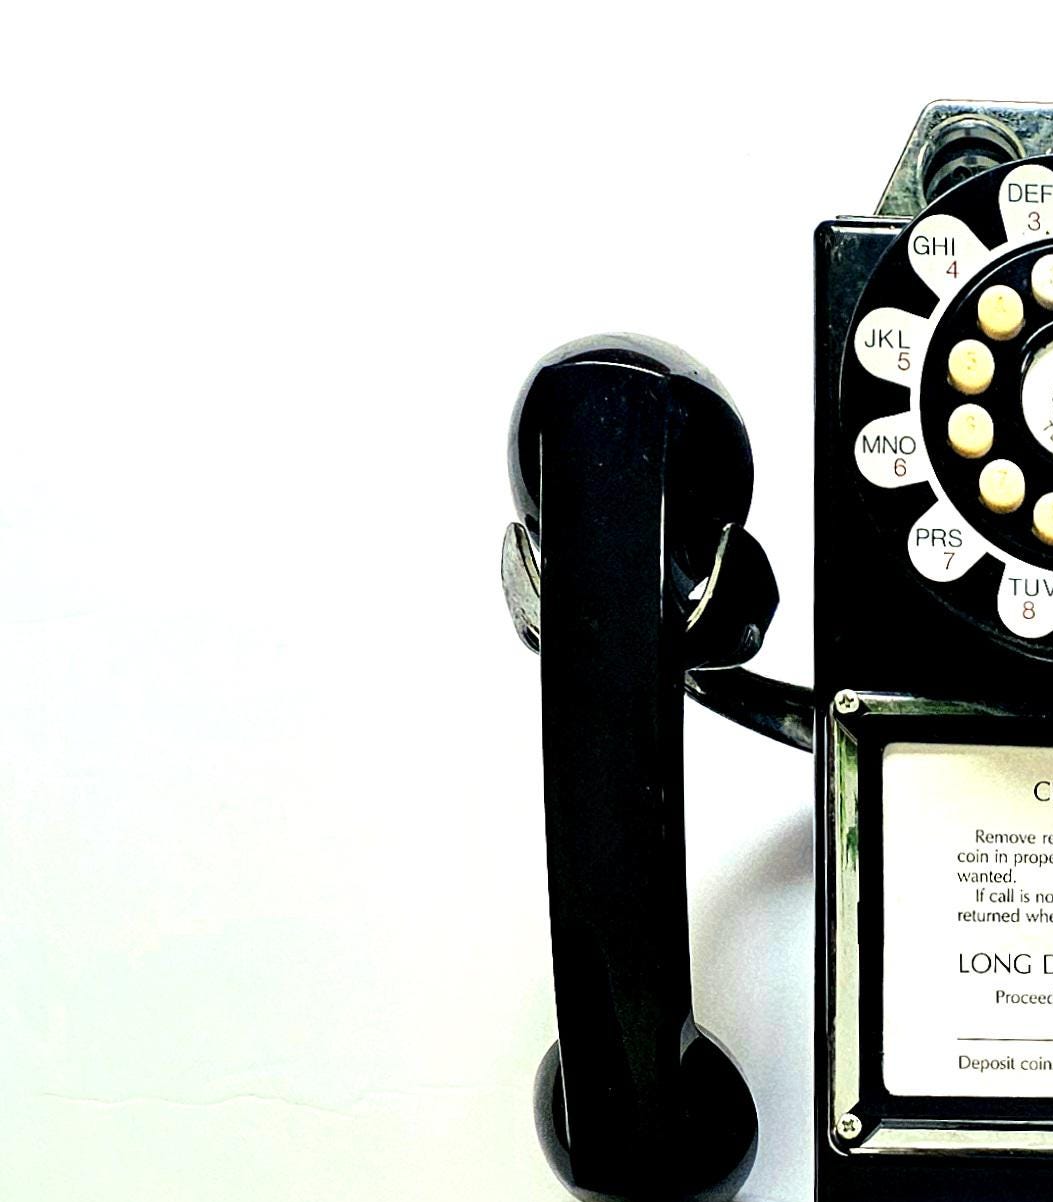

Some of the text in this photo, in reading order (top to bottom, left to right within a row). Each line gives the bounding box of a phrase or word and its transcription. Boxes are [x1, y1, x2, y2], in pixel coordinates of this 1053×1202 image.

[1009, 184, 1052, 203] DEF
[1028, 212, 1040, 231] 3
[914, 236, 954, 256] GHI
[946, 261, 957, 278] 4
[865, 329, 910, 349] JKL
[898, 352, 910, 371] 5
[863, 435, 916, 454] MNO
[894, 458, 906, 477] 6
[917, 528, 962, 547] PRS
[944, 552, 955, 570] 7
[1023, 601, 1035, 619] 8
[976, 830, 1035, 844] Remove
[958, 849, 988, 863] coin
[996, 849, 1007, 863] in
[958, 869, 1016, 883] wanted.
[977, 888, 985, 902] If
[990, 888, 1013, 902] call
[1021, 890, 1030, 903] is
[958, 908, 1019, 922] returned
[960, 953, 1031, 974] LONG
[959, 1056, 1015, 1072] Deposit
